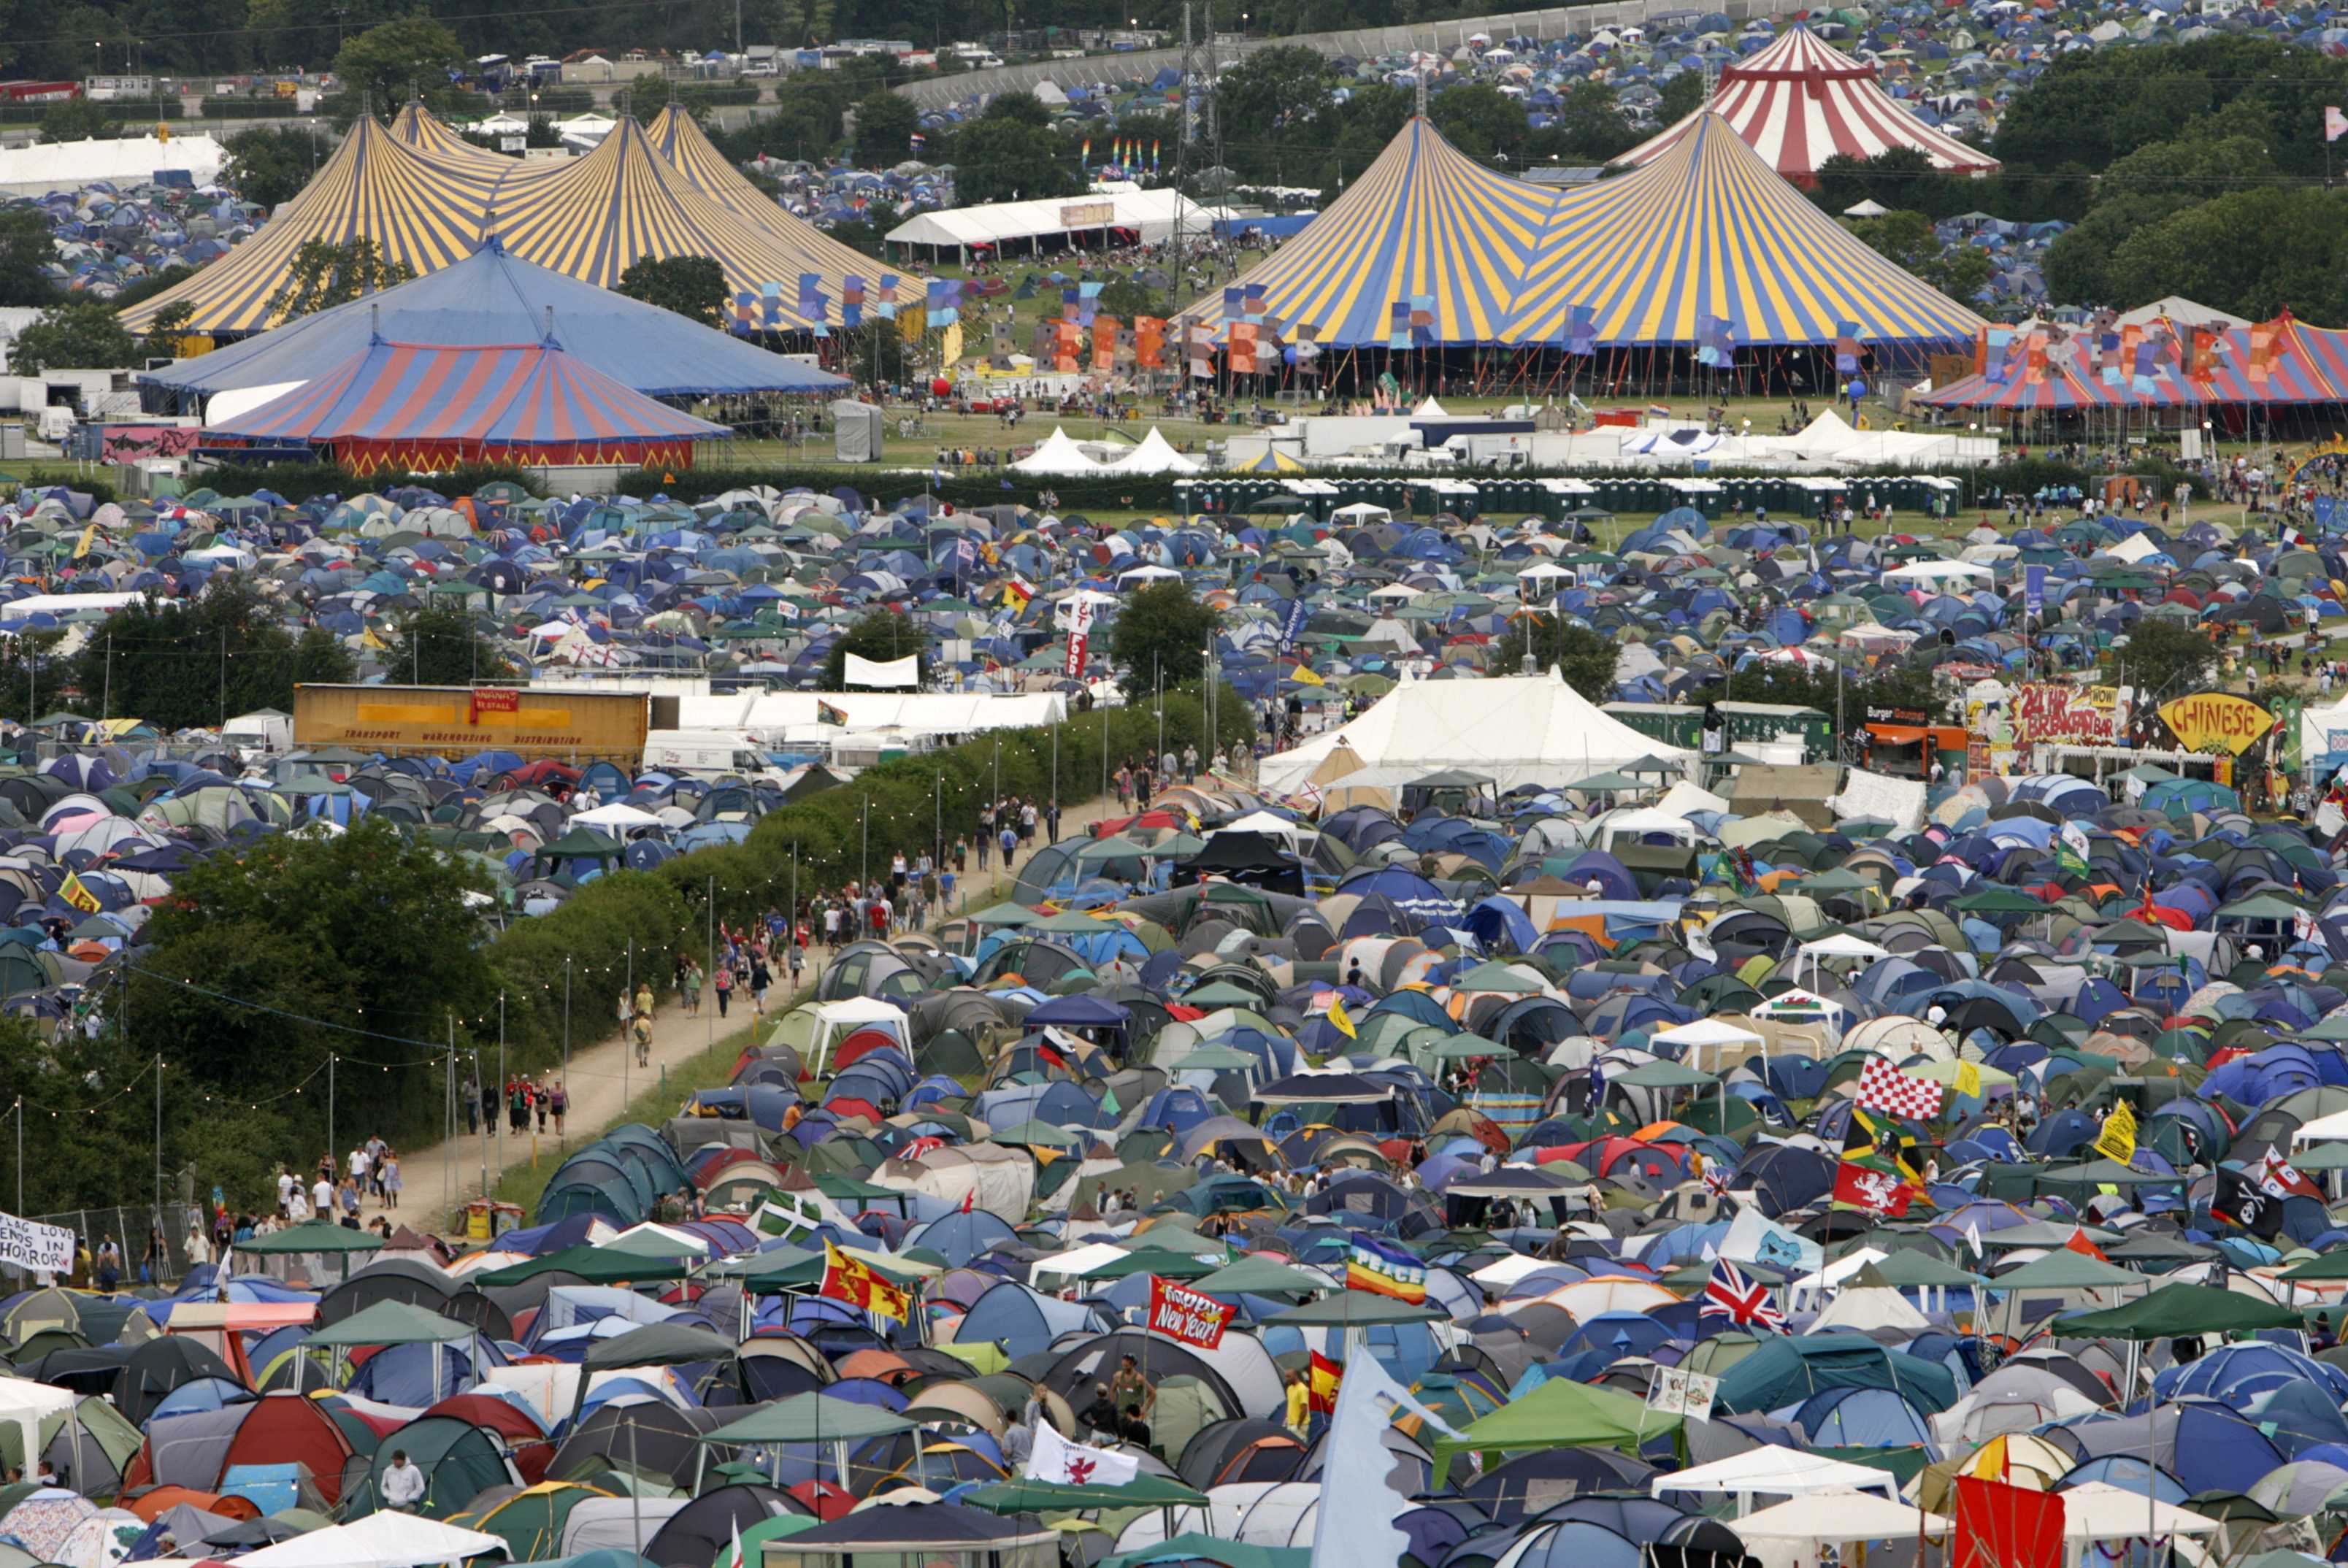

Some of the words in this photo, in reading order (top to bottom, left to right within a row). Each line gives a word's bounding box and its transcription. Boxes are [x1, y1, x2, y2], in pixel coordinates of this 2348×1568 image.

[1285, 599, 1302, 639] outwell
[1069, 634, 1084, 674] FOOD
[1868, 705, 1892, 721] Burger
[2171, 699, 2255, 738] CHINESE
[345, 729, 402, 740] TRANSPORT
[422, 732, 492, 743] WAREHOUSING
[2094, 716, 2113, 737] BAR
[514, 734, 582, 745] DISTRIBUTION
[0, 1227, 33, 1248] ENDS
[46, 1240, 64, 1251] IN
[40, 1226, 74, 1240] LOVE
[0, 1242, 62, 1267] HORROR
[1357, 1249, 1422, 1285] PEACE
[1155, 1302, 1185, 1331] New
[1183, 1312, 1221, 1343] Year!
